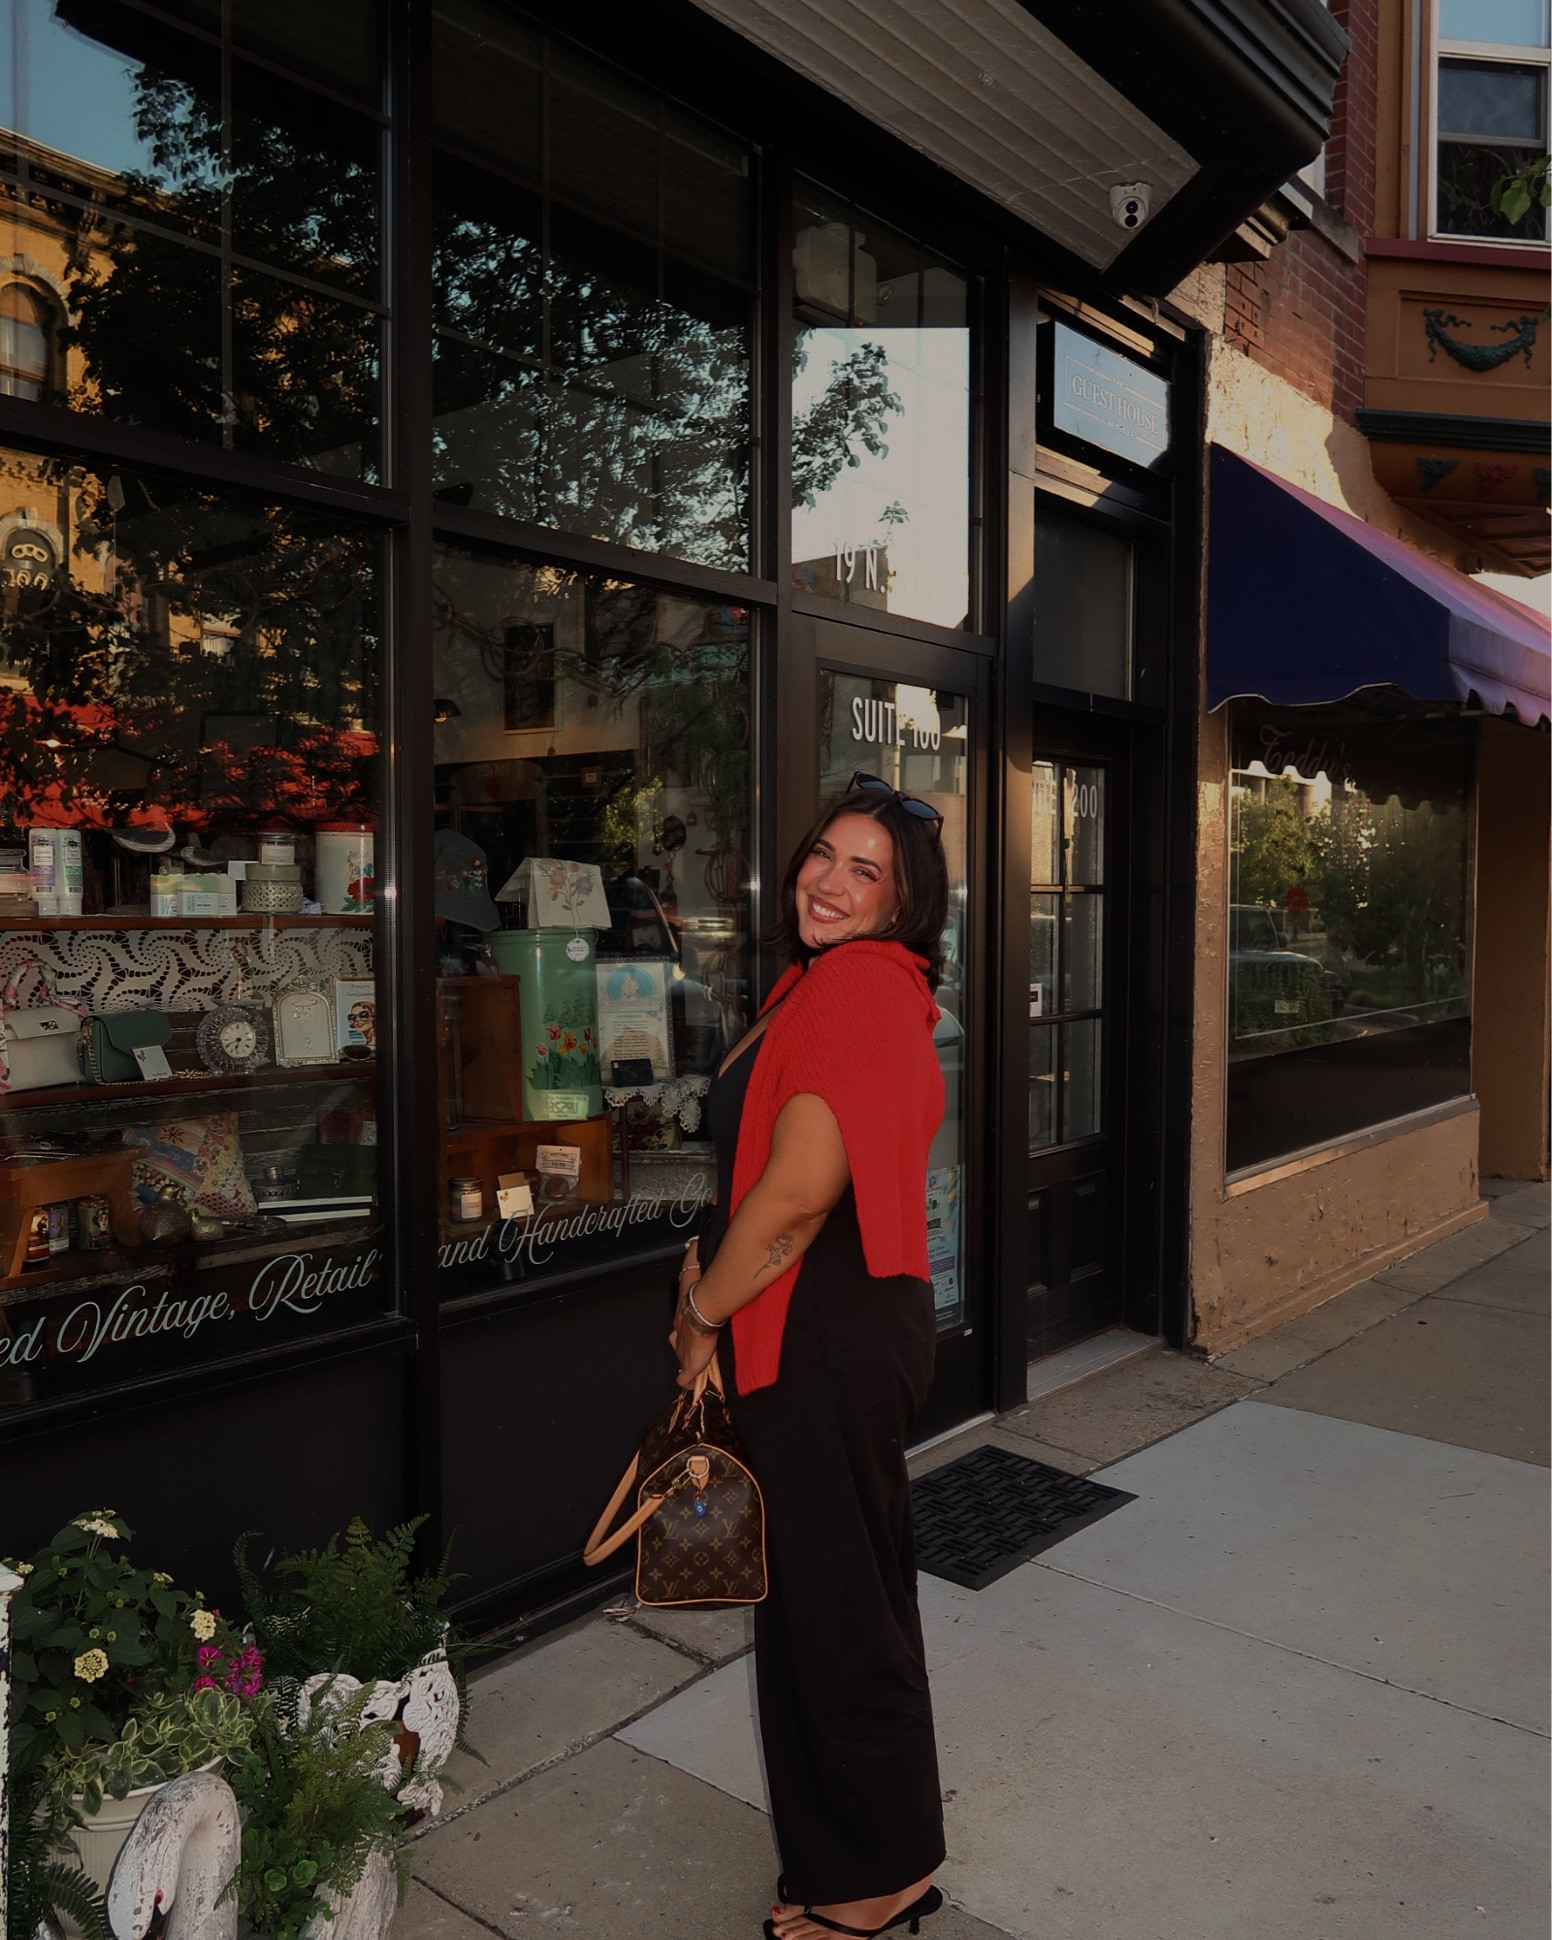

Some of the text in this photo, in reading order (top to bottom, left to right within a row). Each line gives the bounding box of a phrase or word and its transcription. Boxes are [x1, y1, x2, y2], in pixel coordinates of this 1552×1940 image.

[1072, 375, 1159, 436] GUEST HOUSE
[836, 542, 886, 594] 19 N.
[852, 697, 906, 746] SUITE
[1072, 783, 1097, 819] 200
[56, 1285, 236, 1363] Vintage,
[437, 1225, 492, 1268] and
[499, 1189, 664, 1265] Handcrafted
